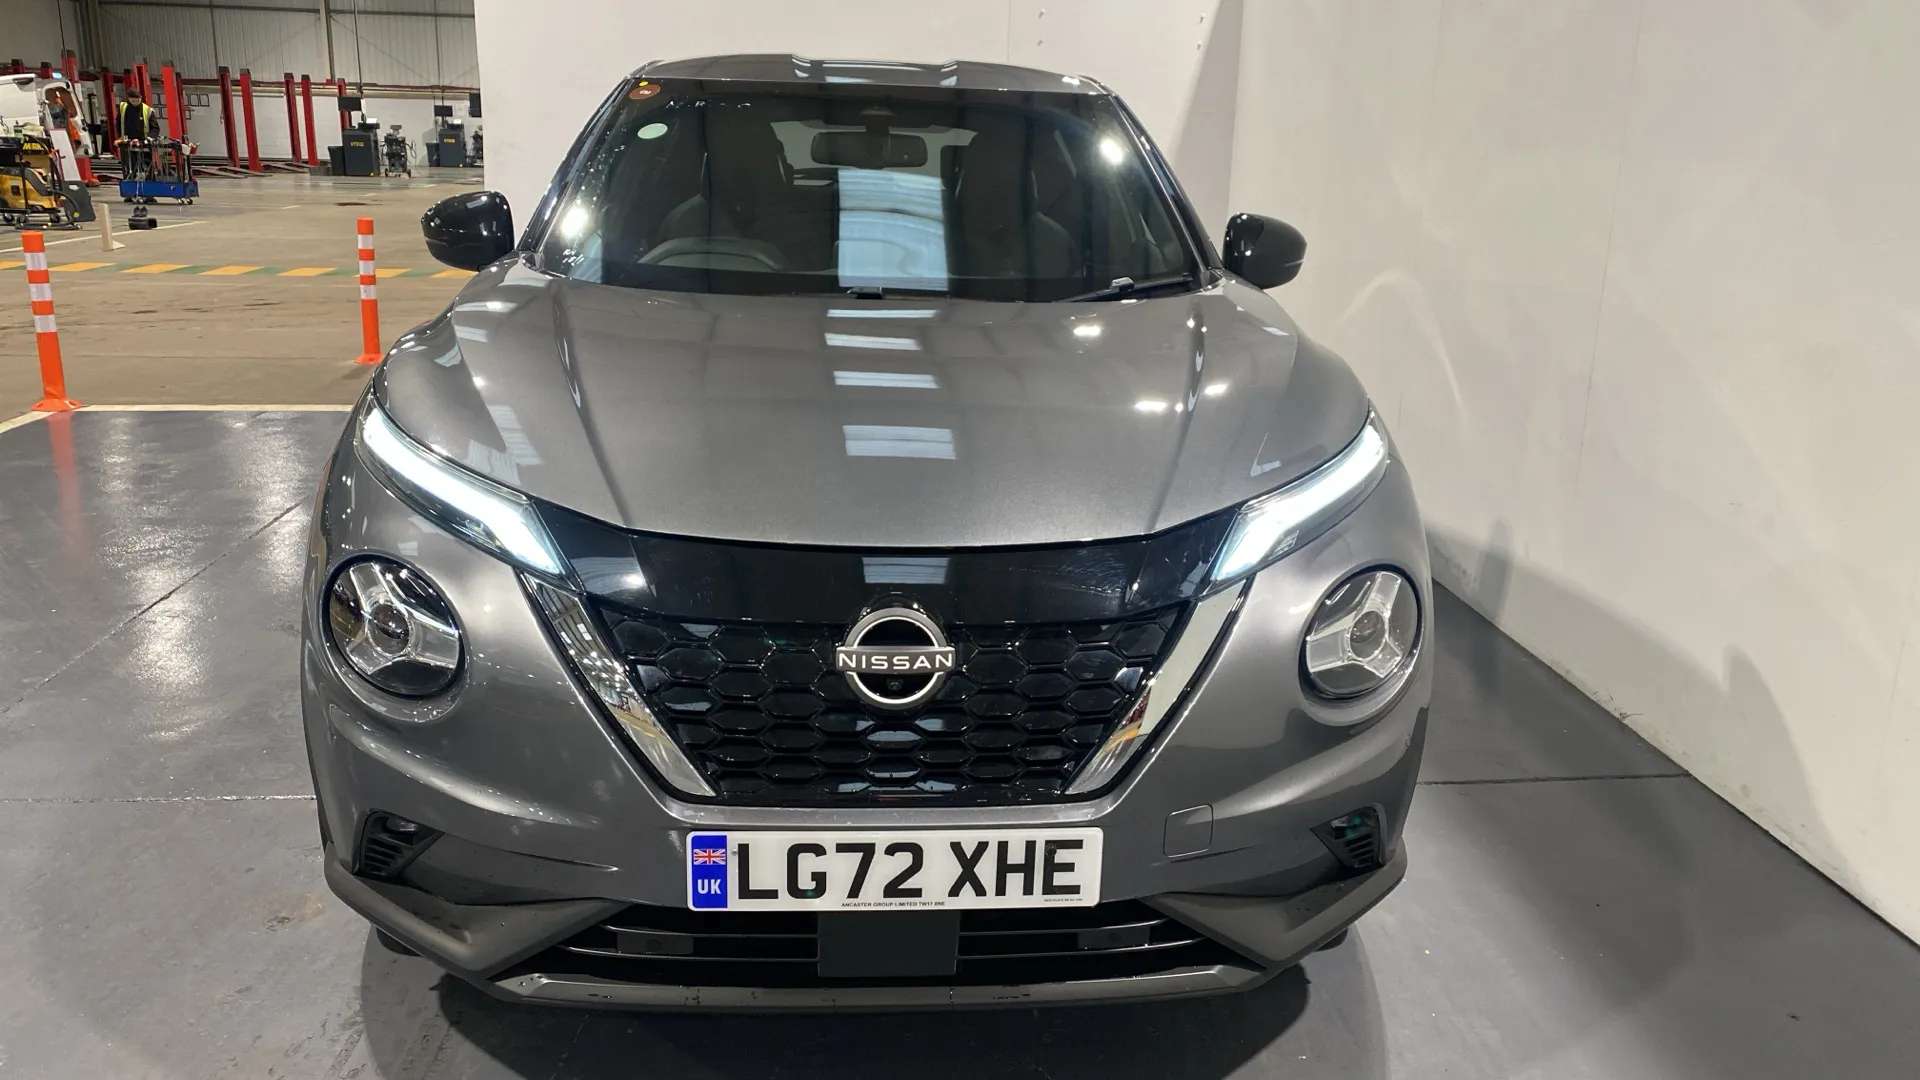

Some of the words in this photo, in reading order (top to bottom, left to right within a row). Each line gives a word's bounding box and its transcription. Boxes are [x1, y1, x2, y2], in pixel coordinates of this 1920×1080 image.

[839, 653, 952, 670] NISSAN
[737, 842, 924, 900] LG72
[948, 839, 1084, 897] XHE
[697, 879, 721, 895] UK
